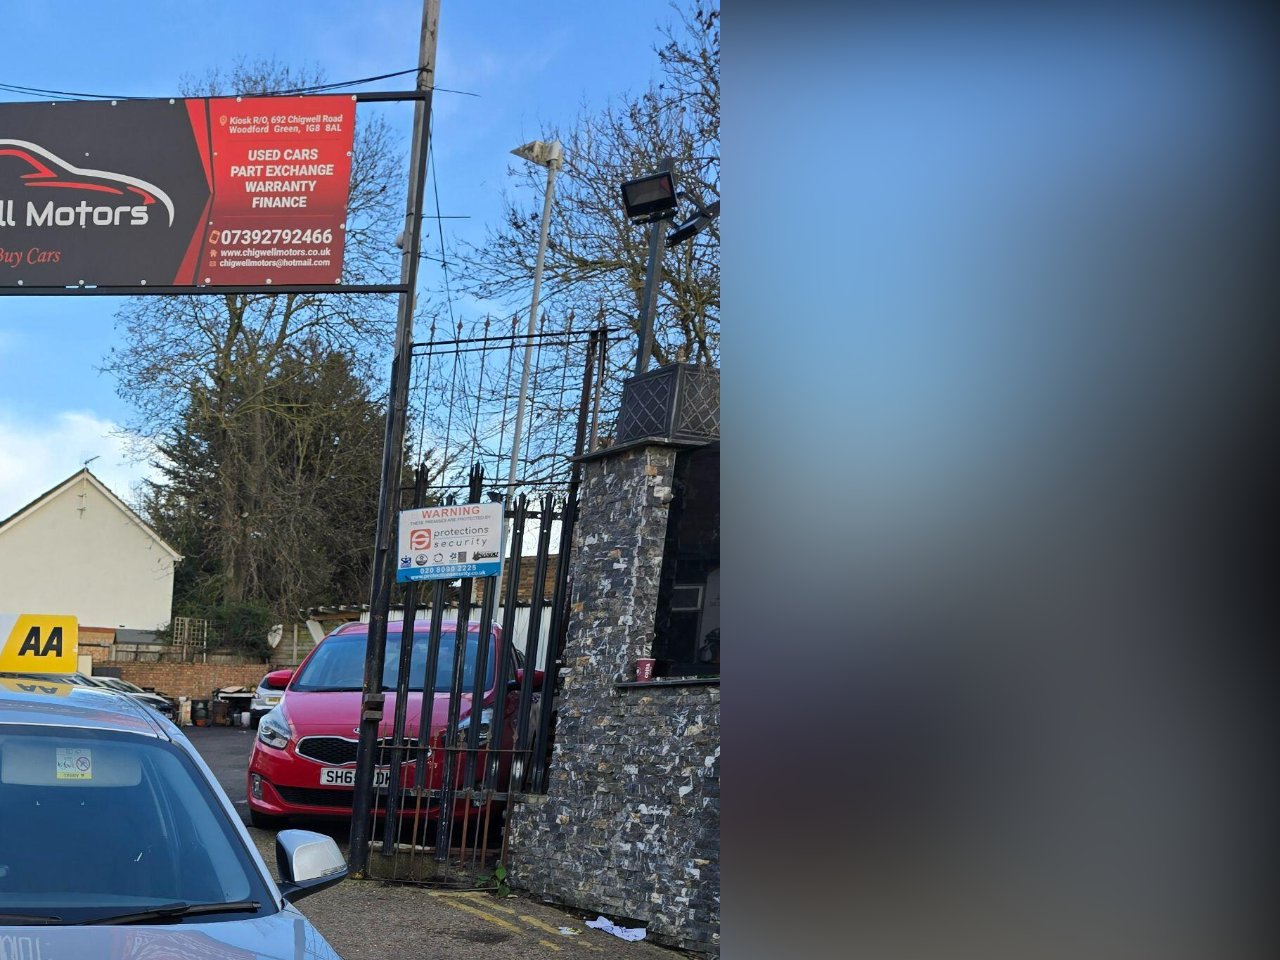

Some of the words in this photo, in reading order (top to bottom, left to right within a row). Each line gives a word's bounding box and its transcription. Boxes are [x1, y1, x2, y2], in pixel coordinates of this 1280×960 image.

[229, 116, 252, 125] Kiosk
[253, 116, 269, 126] R/O,
[271, 115, 286, 124] 692
[287, 114, 320, 125] Chigwell
[322, 114, 343, 123] Road
[229, 125, 269, 134] Woodford
[273, 125, 301, 134] Green,
[325, 124, 342, 132] 8AL
[248, 149, 281, 161] USED
[283, 148, 319, 161] CARS
[230, 165, 263, 177] PART
[265, 163, 334, 176] EXCHANGE
[245, 180, 317, 192] WARRANTY
[252, 196, 308, 208] FINANCE
[26, 200, 149, 228] Motors
[221, 229, 333, 245] 07392792466
[26, 246, 61, 263] Cars
[220, 247, 331, 258] www.chigwellmotors.co.uk
[219, 258, 331, 268] chigwellmotors@hotmail.com
[422, 506, 480, 519] WARNING
[433, 527, 489, 538] protections
[433, 538, 488, 548] security
[420, 567, 434, 575] 020
[17, 626, 63, 657] AA
